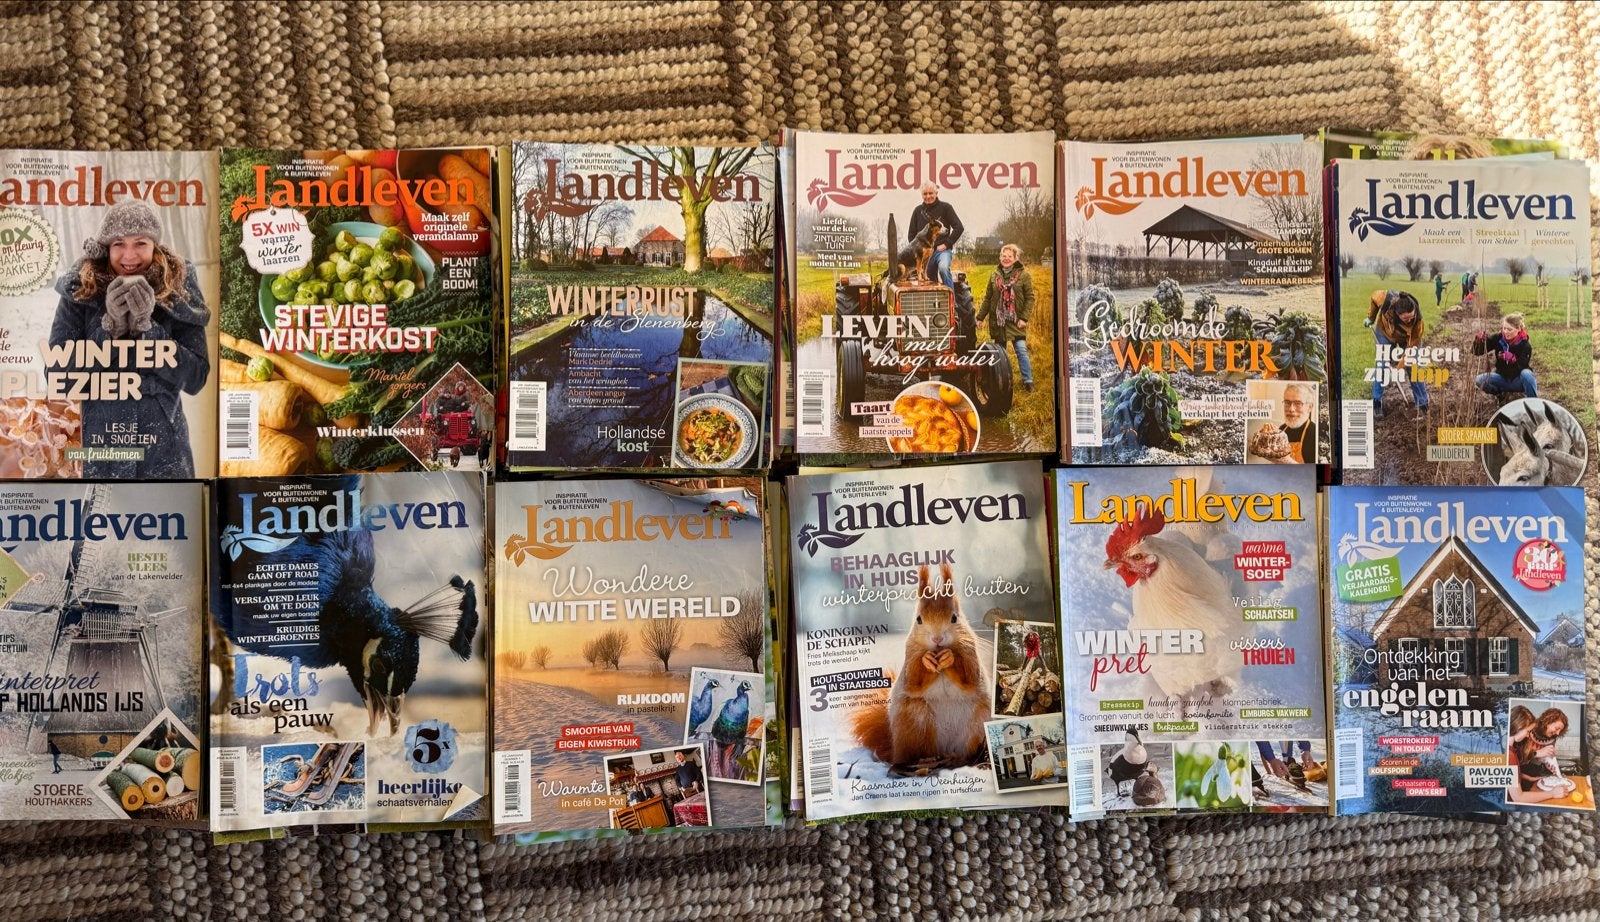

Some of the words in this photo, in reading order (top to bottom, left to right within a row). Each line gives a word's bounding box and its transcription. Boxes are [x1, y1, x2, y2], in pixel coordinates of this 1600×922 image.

[825, 148, 1041, 191] Landleven
[543, 158, 763, 202] Landleven
[1091, 157, 1309, 199] Landleven
[0, 165, 206, 207] andleven
[248, 164, 478, 208] Landleven
[1365, 178, 1576, 220] Landleven
[421, 212, 449, 222] Maak
[451, 212, 471, 222] zelf
[822, 217, 847, 225] Liefde
[423, 222, 468, 233] originele
[1535, 229, 1570, 238] Winterse
[260, 233, 295, 245] warme
[413, 231, 479, 242] verandalamp
[814, 234, 856, 243] ZINTUIGEN
[825, 242, 845, 250] TUIN
[262, 254, 300, 266] laarzen
[442, 256, 478, 268] PLANT
[449, 268, 471, 278] EEN
[442, 279, 478, 290] BOOM!
[1240, 277, 1313, 285] WINTERRABARBER
[546, 284, 698, 317] WINTERRUST
[274, 304, 389, 329] STEVIGE
[821, 315, 933, 338] LEVEN
[1083, 300, 1229, 351] Gedroomde
[259, 327, 440, 353] WINTERKOST
[39, 339, 178, 369] WINTER
[1109, 339, 1281, 374] WINTER
[1375, 343, 1461, 367] Heggen
[1363, 361, 1406, 387] zijn
[2, 371, 143, 401] PLEZIER
[1204, 395, 1248, 403] Allerbeste
[854, 403, 891, 414] Taart
[1184, 410, 1219, 419] verklapt
[1237, 410, 1269, 419] geheim
[876, 416, 889, 424] van
[890, 415, 900, 424] de
[105, 422, 139, 433] LESJE
[316, 425, 425, 439] Winterklussen
[597, 425, 666, 439] Hollandse
[862, 426, 887, 436] laatste
[887, 427, 912, 437] appels
[91, 434, 105, 445] IN
[110, 434, 157, 445] SNOEIEN
[1441, 429, 1465, 441] STOERE
[1466, 430, 1495, 442] SPAANSE
[616, 439, 650, 453] kost
[68, 450, 86, 460] van
[88, 447, 141, 462] fruitbomen
[1431, 447, 1470, 460] MUILDIEREN
[811, 482, 1032, 534] Landleven
[1068, 477, 1305, 525] Landleven
[238, 489, 469, 537] Landleven
[1354, 501, 1569, 544] Landleven
[1245, 543, 1284, 554] warme
[127, 552, 168, 562] BESTE
[830, 548, 956, 572] BEHAAGLIJK
[1237, 556, 1290, 568] WINTER-
[127, 562, 168, 572] VLEES
[256, 564, 287, 572] ECHTE
[288, 563, 319, 571] DAMES
[1345, 564, 1391, 582] GRATIS
[111, 573, 125, 581] van
[126, 572, 136, 580] de
[138, 572, 183, 581] Lakenvelder
[247, 572, 273, 581] GAAN
[543, 563, 694, 598] Wondere
[843, 573, 864, 590] IN
[871, 569, 919, 588] HUIS
[1246, 569, 1281, 580] SOEP
[1341, 575, 1398, 592] VERJAARDAGS-
[822, 578, 957, 613] winterpracht
[963, 573, 1030, 598] buiten
[1349, 584, 1391, 598] KALENDER!
[234, 594, 294, 605] VERSLAVEND
[263, 603, 279, 611] OM
[528, 599, 617, 623] WITTE
[624, 596, 741, 620] WERELD
[1244, 608, 1294, 620] SCHAATSEN
[276, 625, 320, 634] KRUIDIGE
[806, 626, 863, 640] KONINGIN
[866, 623, 889, 634] VAN
[237, 633, 320, 644] WINTERGROENTES
[807, 640, 823, 651] DE
[824, 636, 876, 649] SCHAPEN
[1074, 629, 1205, 656] WINTER
[1229, 637, 1286, 651] vissers
[1240, 648, 1296, 666] TRUIEN
[1363, 647, 1460, 668] Ontdekking
[1090, 642, 1152, 692] pret
[1388, 667, 1418, 681] van
[1424, 666, 1452, 680] het
[223, 653, 323, 704] Trots
[813, 669, 880, 685] HOUTSJOUWEN
[840, 679, 889, 691] STAATSBOS
[17, 691, 108, 713] HOLLANDS
[114, 691, 143, 712] IJS
[617, 692, 685, 705] RIJKDOM
[809, 687, 829, 712] 3
[1342, 682, 1479, 716] engelen-
[230, 696, 261, 716] als
[268, 698, 309, 713] een
[627, 706, 635, 714] in
[637, 704, 676, 715] pastelkrijt
[1079, 713, 1117, 722] Groningen
[1156, 711, 1175, 719] lucht
[1241, 709, 1275, 718] LIMBURGS
[1276, 709, 1309, 717] VAKWERK
[1400, 708, 1495, 728] raam
[273, 712, 335, 733] pauw
[565, 726, 612, 736] SMOOTHIE
[612, 724, 631, 734] VAN
[558, 739, 586, 749] EIGEN
[587, 737, 638, 748] KIWISTRUIK
[1382, 737, 1435, 745] WORSTROKERIJ
[1455, 755, 1486, 764] Plezier
[1489, 756, 1503, 764] van
[1469, 767, 1514, 777] PAVLOVA
[1470, 776, 1513, 786] IJS-STER
[33, 784, 84, 796] STOERE
[377, 778, 463, 800] heerlijke
[538, 779, 606, 798] Warmte
[25, 797, 93, 806] HOUTHAKKERS
[561, 799, 570, 807] in
[572, 797, 592, 807] café
[594, 797, 607, 806] De
[609, 796, 624, 806] Pot
